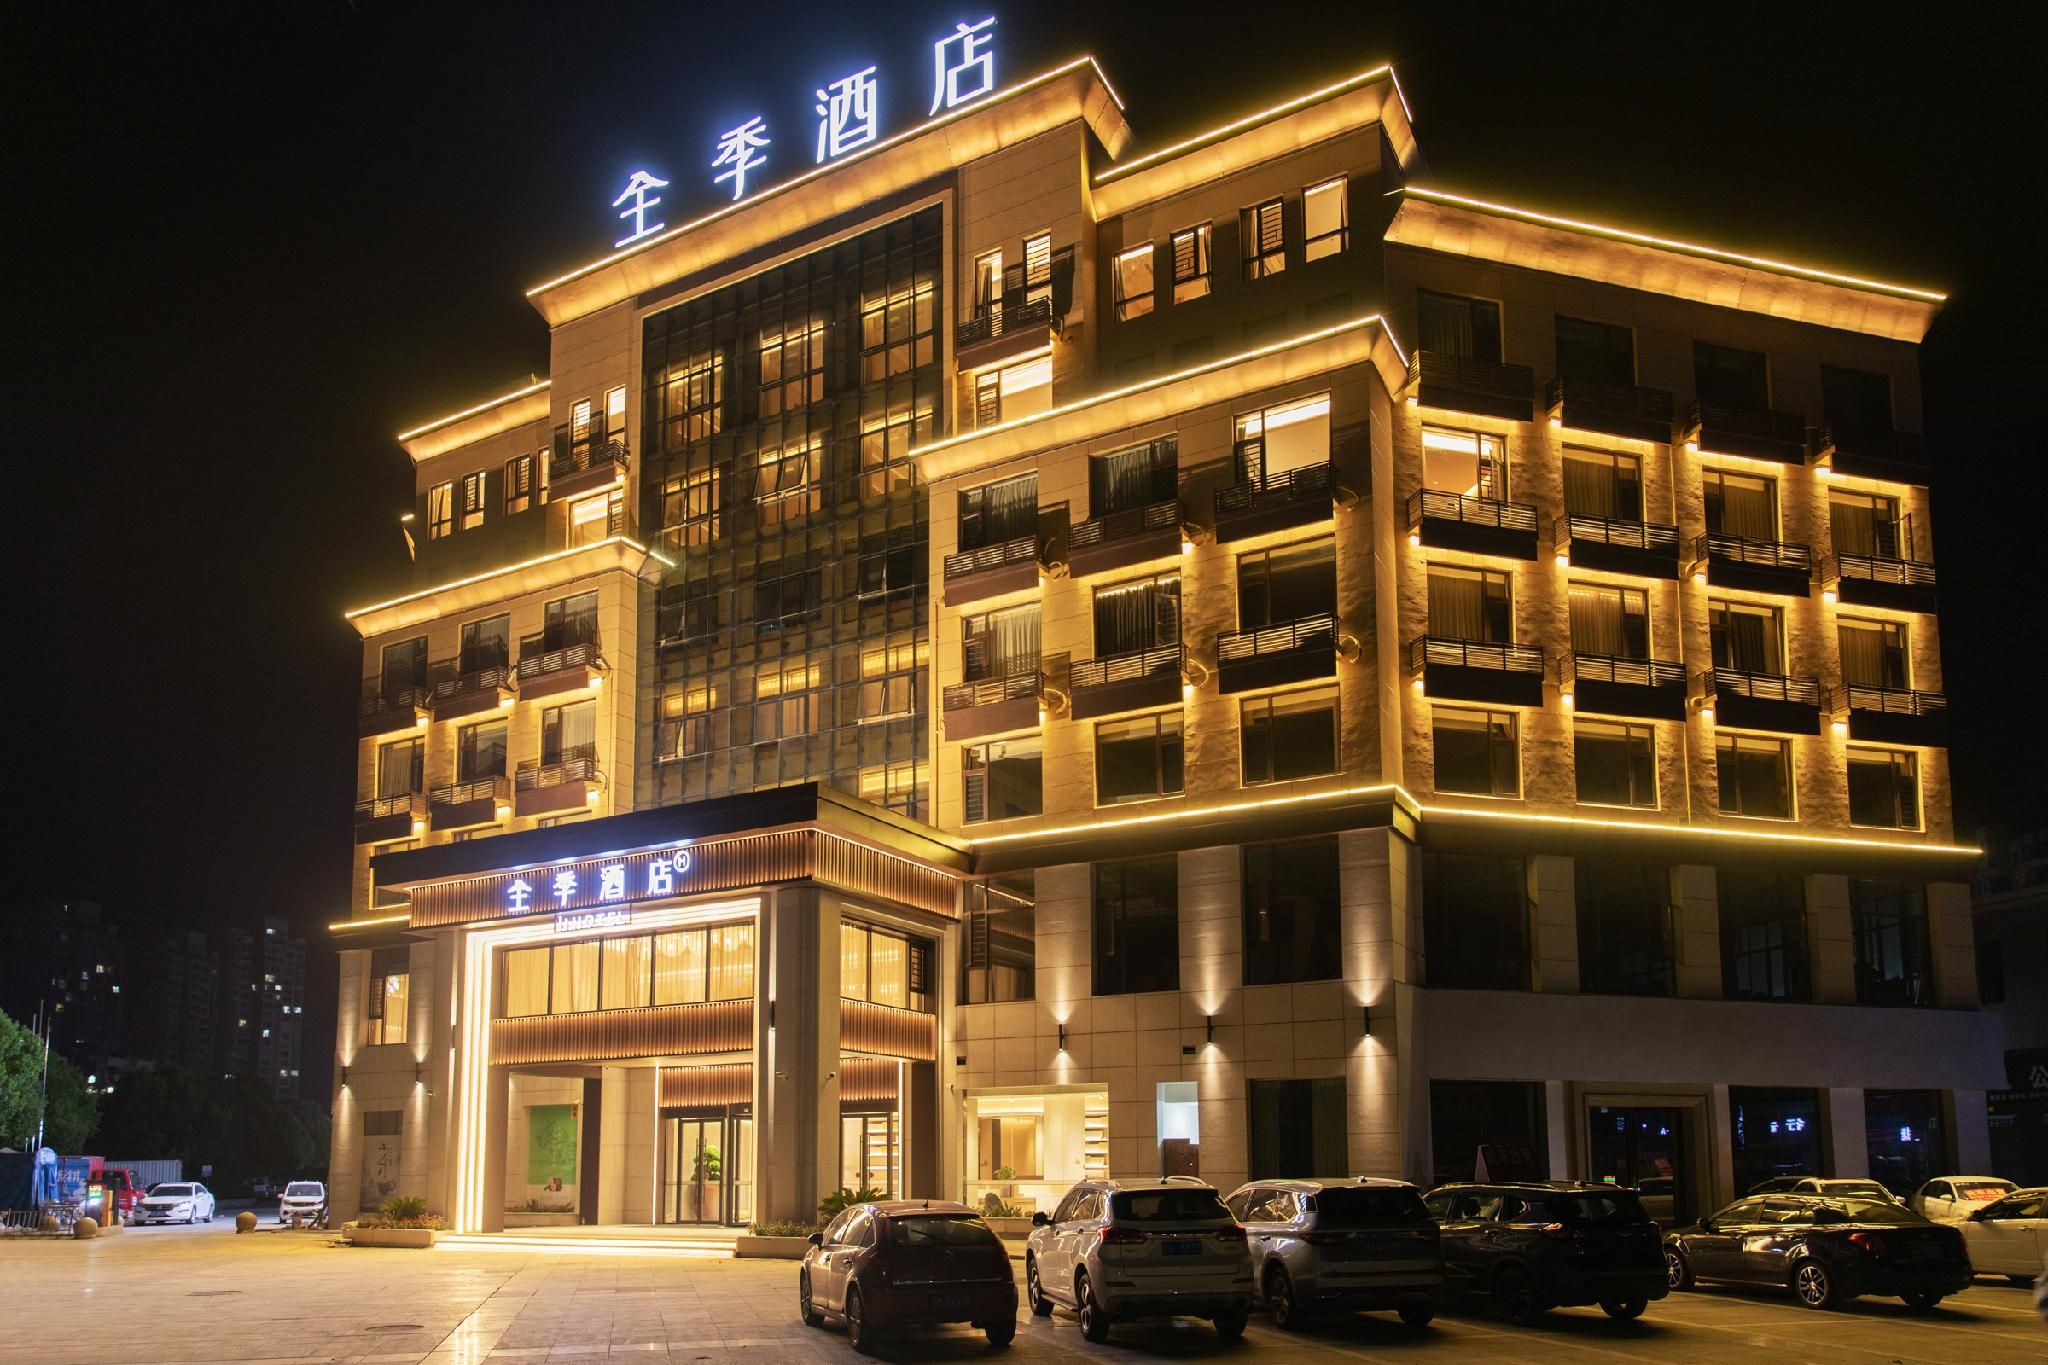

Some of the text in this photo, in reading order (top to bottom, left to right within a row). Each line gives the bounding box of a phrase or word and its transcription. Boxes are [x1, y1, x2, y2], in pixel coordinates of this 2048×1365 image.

[613, 16, 997, 247] 全季酒店
[507, 858, 672, 912] 全季酒店
